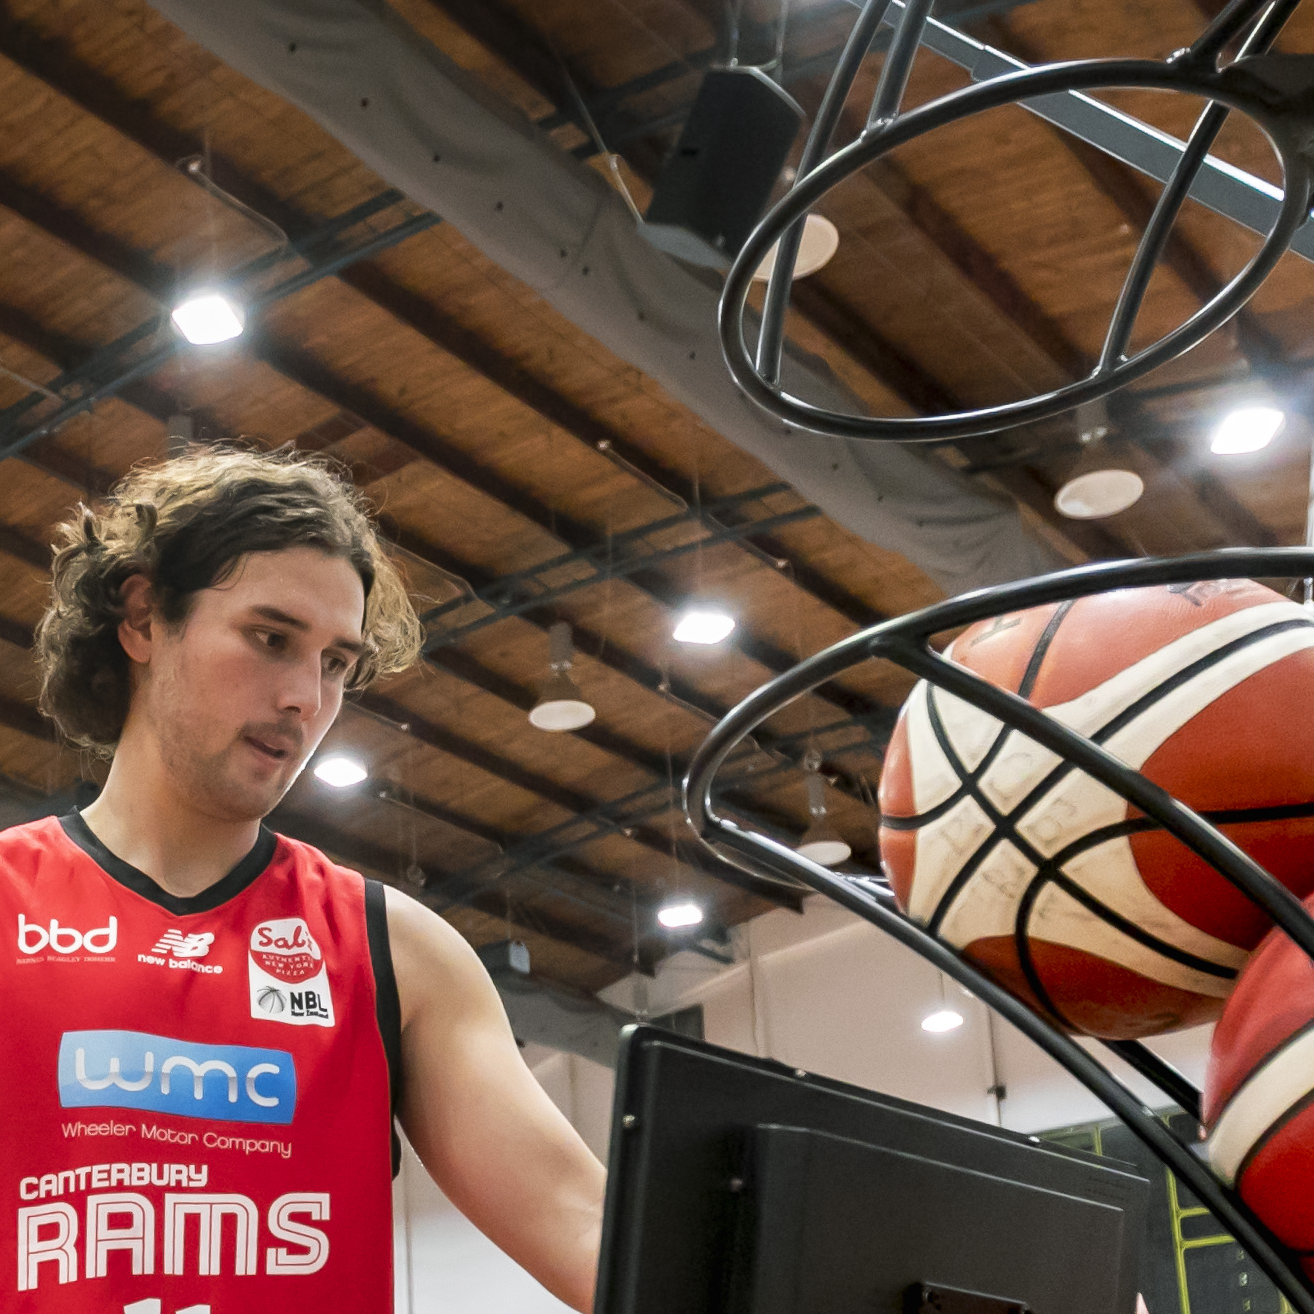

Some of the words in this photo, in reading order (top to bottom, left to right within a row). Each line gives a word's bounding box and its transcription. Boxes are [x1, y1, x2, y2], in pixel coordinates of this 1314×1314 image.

[18, 913, 117, 954] bbd
[138, 953, 166, 967] new
[169, 957, 223, 974] balance
[290, 990, 327, 1012] NBL
[75, 1047, 280, 1107] wmc
[62, 1120, 136, 1138] Wheeler
[141, 1124, 199, 1144] Motor
[203, 1132, 292, 1158] Company
[20, 1162, 208, 1200] CANTERBURY
[18, 1192, 330, 1292] RAMS
